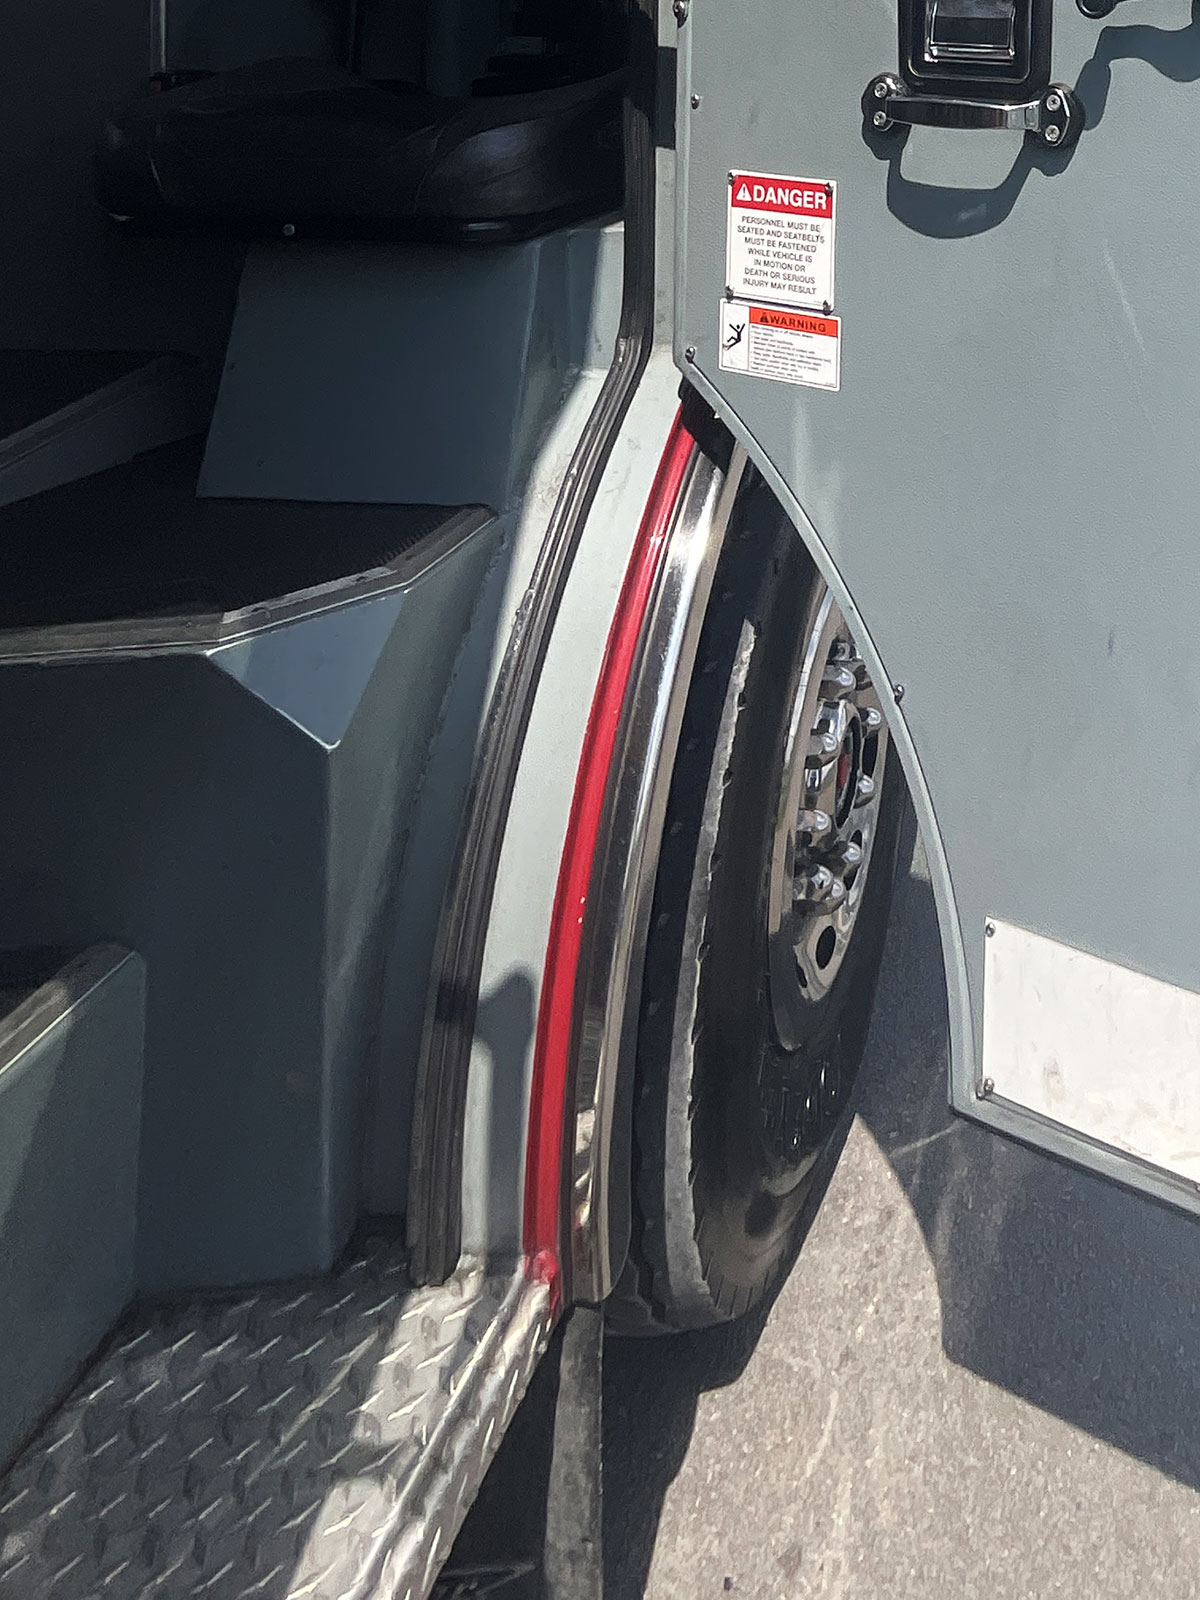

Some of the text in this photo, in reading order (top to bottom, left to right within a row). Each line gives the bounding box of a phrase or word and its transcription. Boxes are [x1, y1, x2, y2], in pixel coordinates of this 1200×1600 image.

[753, 184, 827, 210] DANGER
[741, 215, 820, 232] PERSONNEL MUST BE
[737, 225, 825, 244] SEATED AND SEATBELTS
[744, 237, 817, 253] MUST BE FASTENED
[748, 247, 813, 263] WHILE VEHICLE IS
[763, 260, 793, 271] MOTION
[794, 264, 806, 272] OR
[744, 267, 815, 284] DEATH OR SERIOUS
[743, 278, 817, 295] INJURY MAY RESULT
[770, 315, 826, 333] WARNING
